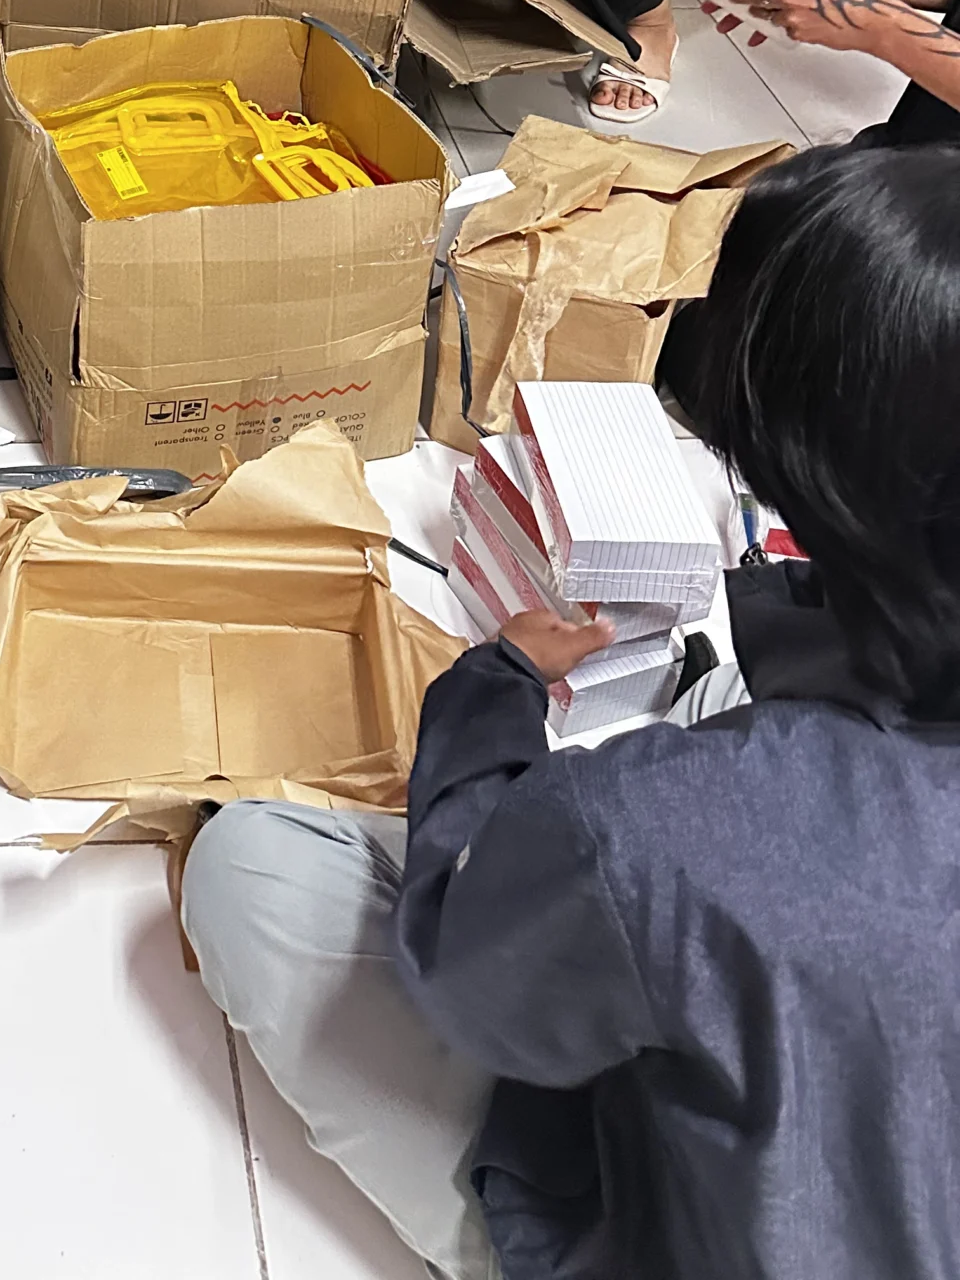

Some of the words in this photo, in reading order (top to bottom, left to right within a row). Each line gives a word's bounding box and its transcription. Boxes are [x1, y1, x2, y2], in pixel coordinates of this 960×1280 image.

[292, 412, 311, 420] Blue
[236, 419, 266, 428] Yellow
[183, 426, 210, 434] Other
[235, 428, 265, 436] Green
[154, 435, 208, 447] Transparent
[271, 434, 289, 443] PCS
